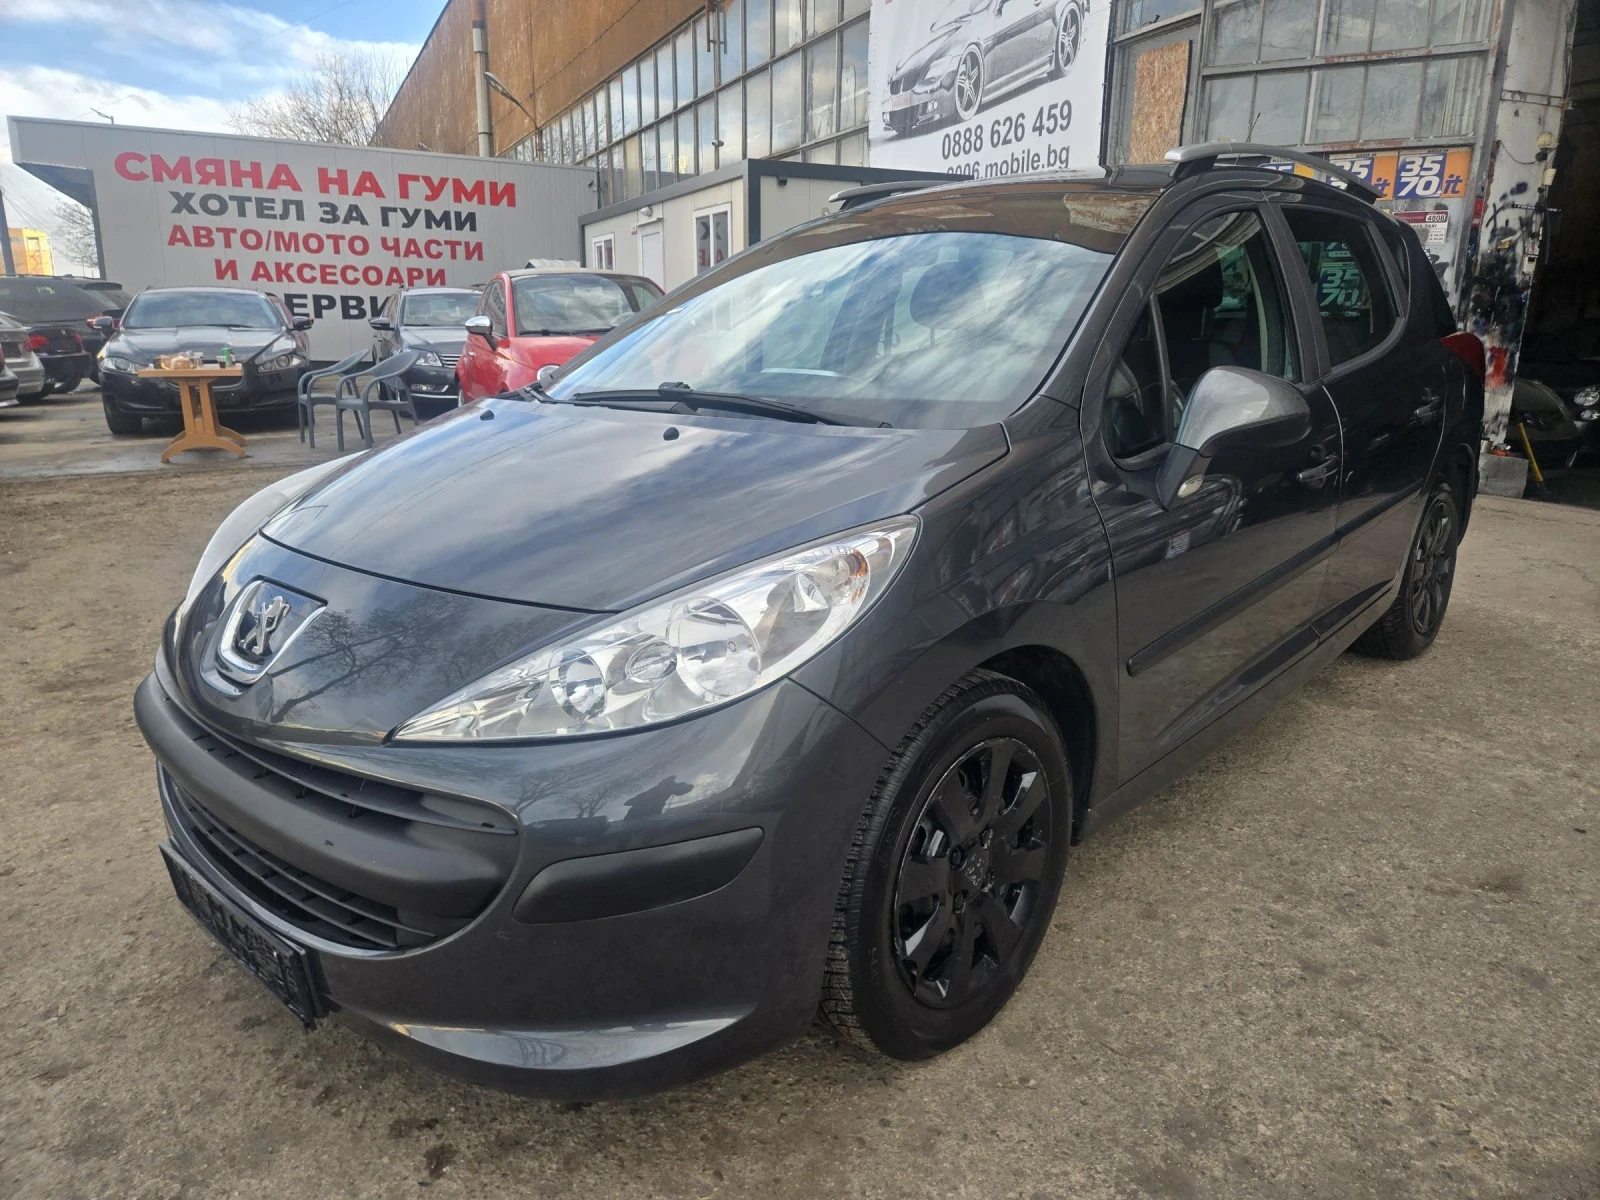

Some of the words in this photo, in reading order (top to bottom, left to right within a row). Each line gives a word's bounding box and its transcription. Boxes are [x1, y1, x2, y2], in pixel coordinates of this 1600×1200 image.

[942, 124, 983, 160] 0888
[990, 112, 1026, 148] 626
[1032, 100, 1072, 137] 459
[114, 152, 303, 192] СМЯНА
[317, 167, 386, 198] НА
[398, 173, 516, 207] ГУМИ
[1400, 156, 1443, 176] 35
[168, 191, 305, 222] ХОТЕЛ
[318, 202, 369, 226] ЗА
[380, 206, 477, 232] ГУМИ
[167, 224, 369, 256] АВТО/МОТО
[381, 236, 484, 261] ЧАСТИ
[214, 259, 239, 280] И
[251, 261, 446, 287] АКСЕСОАРИ
[265, 292, 390, 320] ЕРВИ
